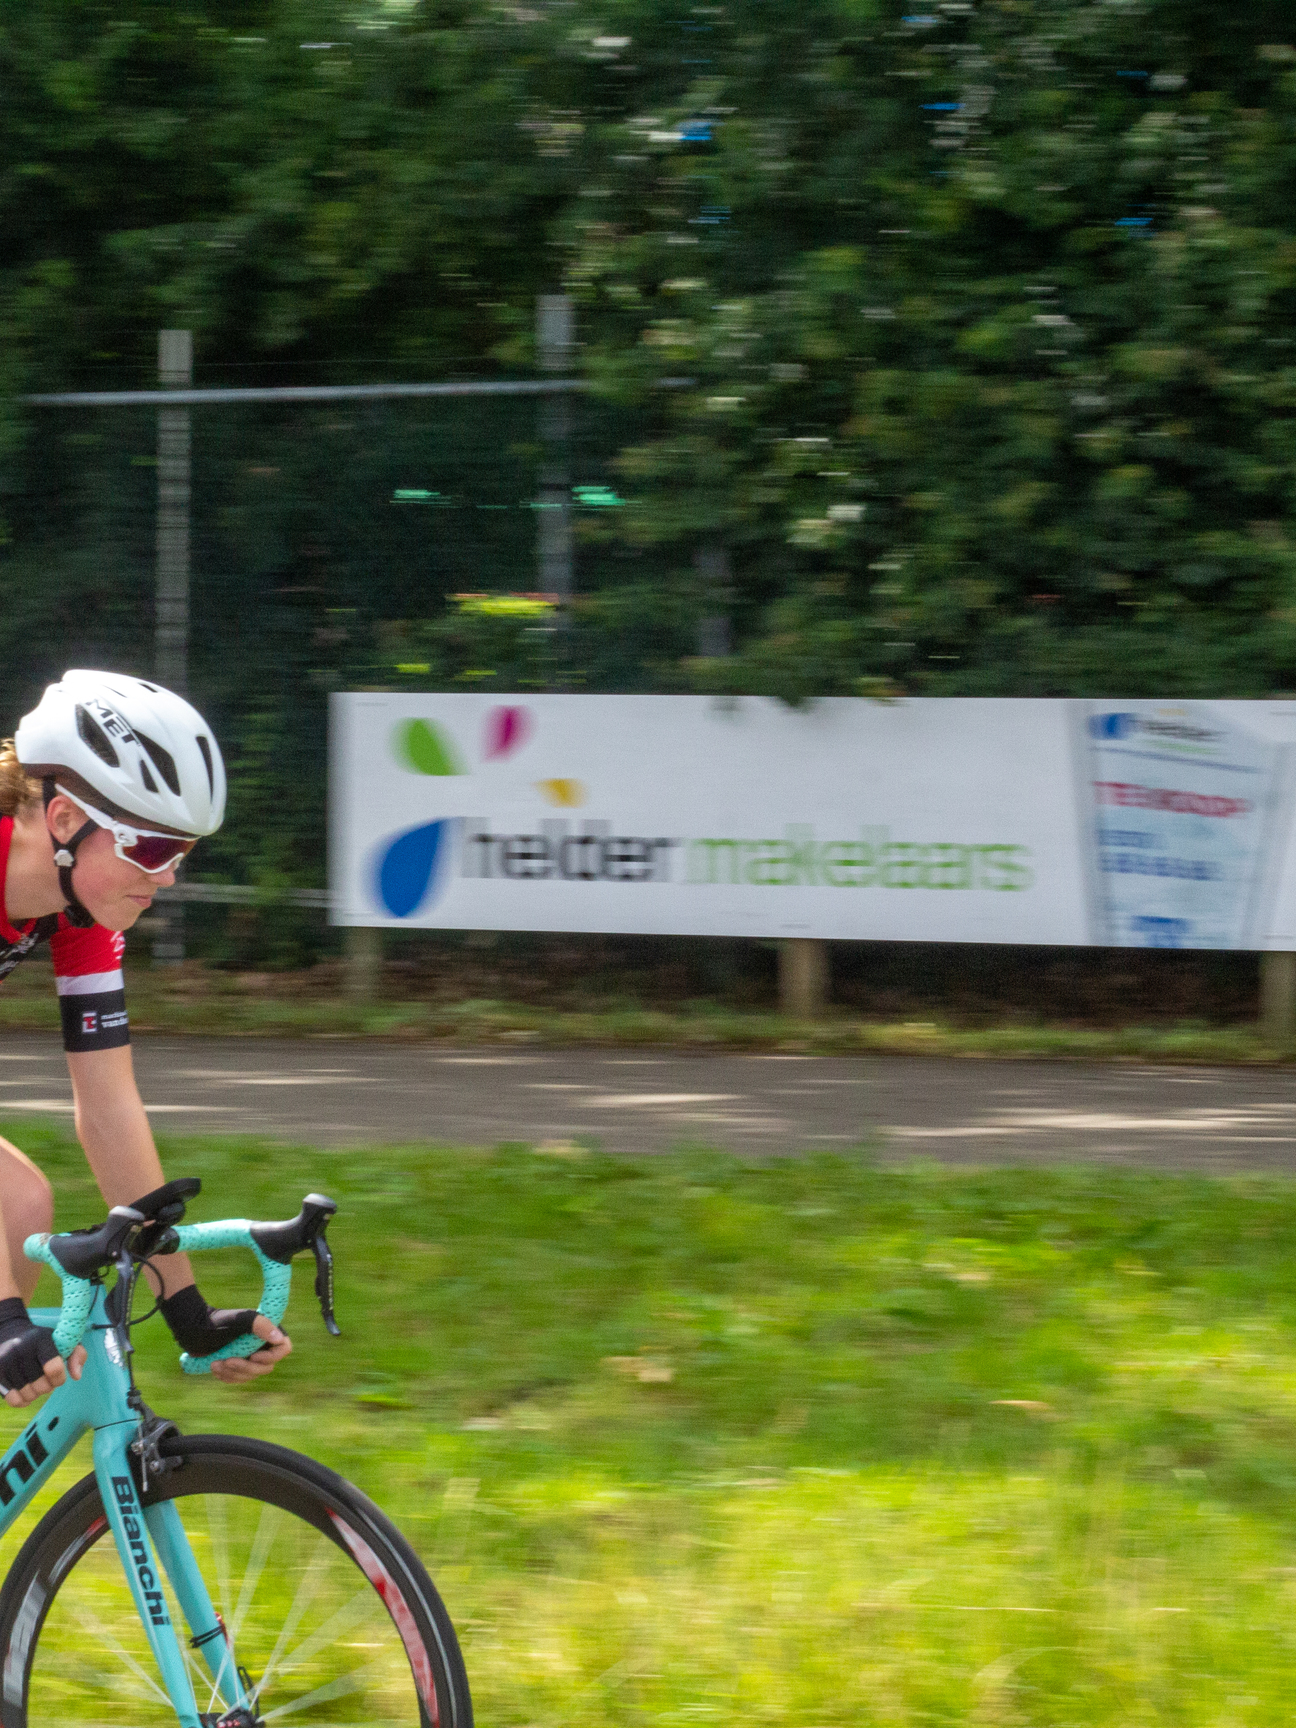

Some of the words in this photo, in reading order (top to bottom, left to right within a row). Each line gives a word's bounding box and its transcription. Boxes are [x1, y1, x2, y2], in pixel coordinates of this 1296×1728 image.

[85, 699, 142, 746] MET
[682, 822, 1036, 893] makelaars
[111, 1476, 171, 1626] Bianchi
